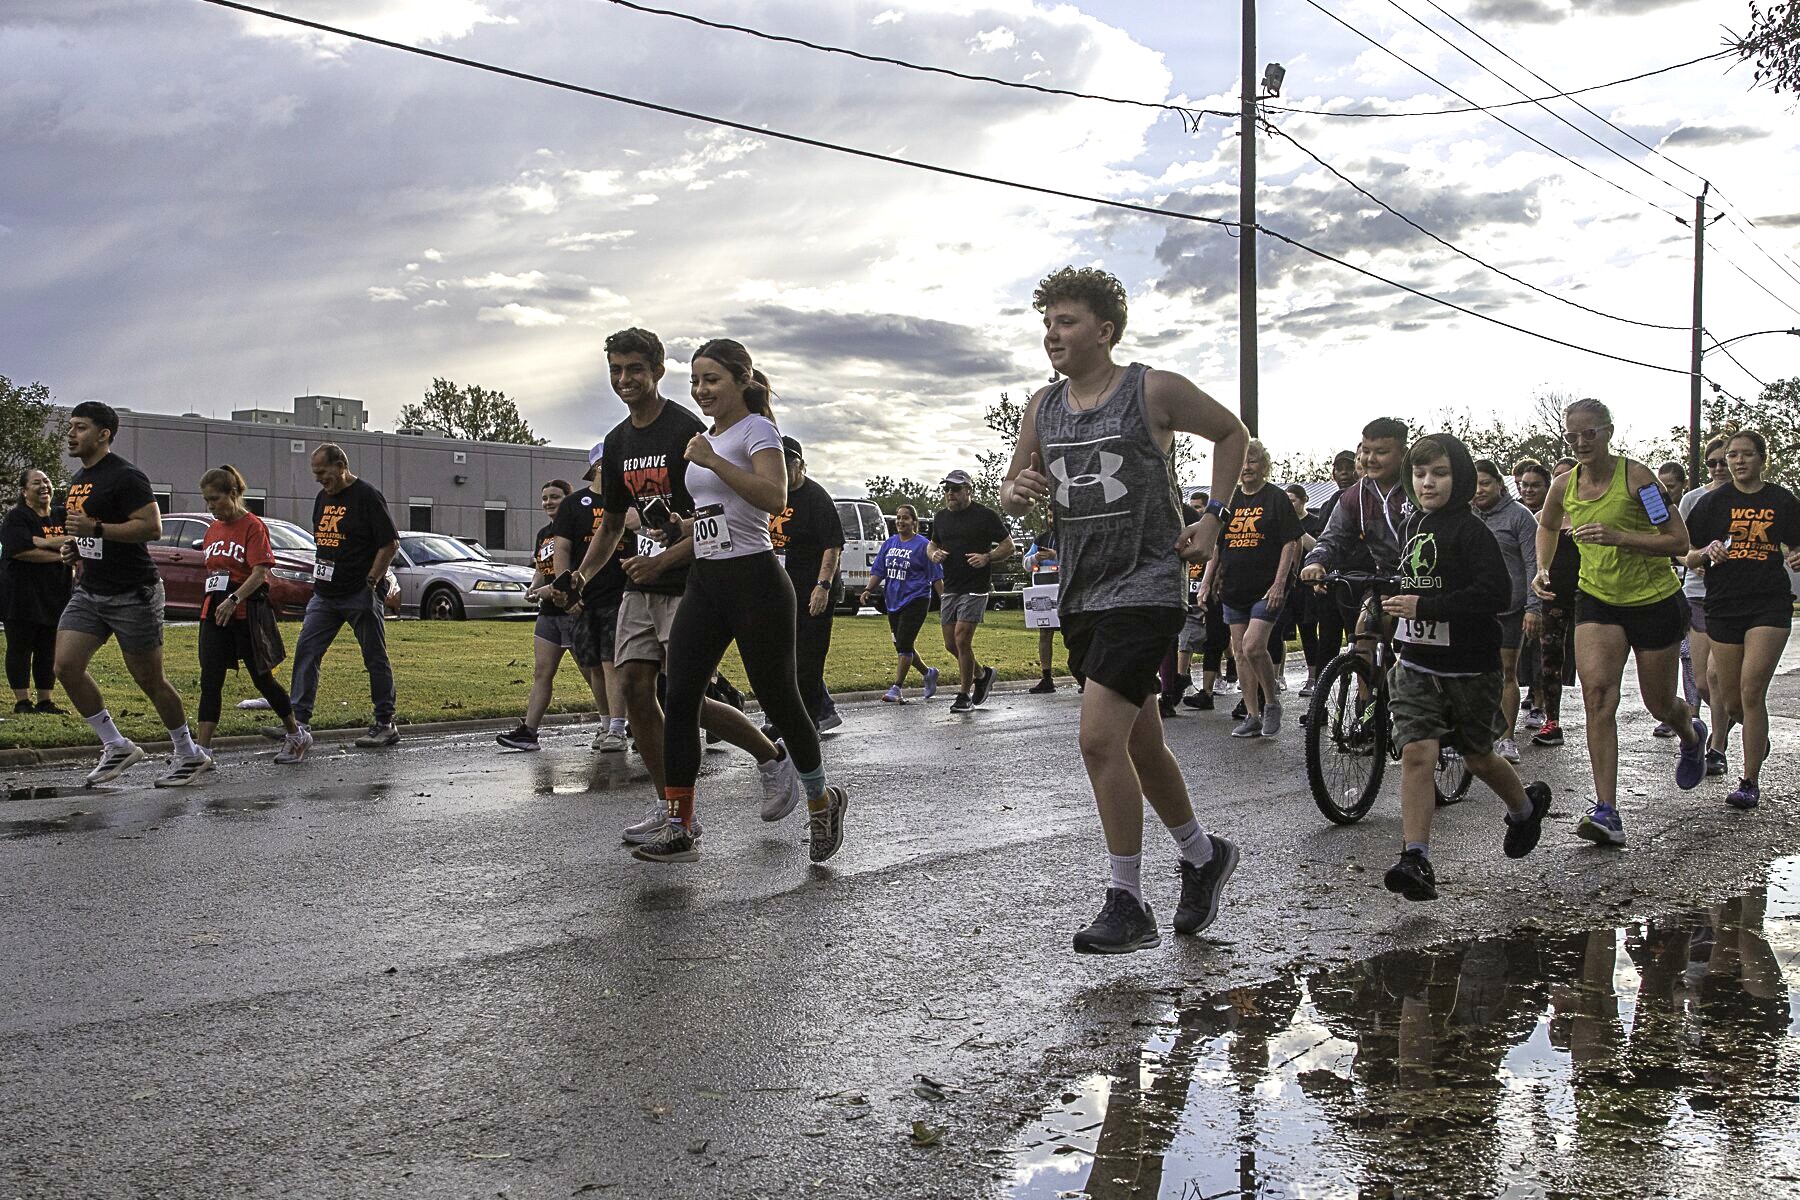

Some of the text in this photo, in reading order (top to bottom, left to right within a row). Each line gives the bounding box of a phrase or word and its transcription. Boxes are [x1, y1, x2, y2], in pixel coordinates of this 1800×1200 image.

[69, 484, 93, 495] WCJC
[323, 505, 347, 515] WCJC
[1234, 507, 1264, 516] WCJC
[1731, 508, 1775, 520] WCJC
[318, 515, 344, 533] 5K
[695, 518, 718, 542] 200
[1228, 516, 1262, 533] 5K
[1728, 520, 1774, 542] 5K
[317, 539, 339, 547] 2025
[1229, 540, 1259, 548] 2025
[1728, 549, 1769, 561] 2025
[317, 565, 327, 577] 83
[208, 577, 219, 588] 82
[1405, 619, 1437, 640] 197
